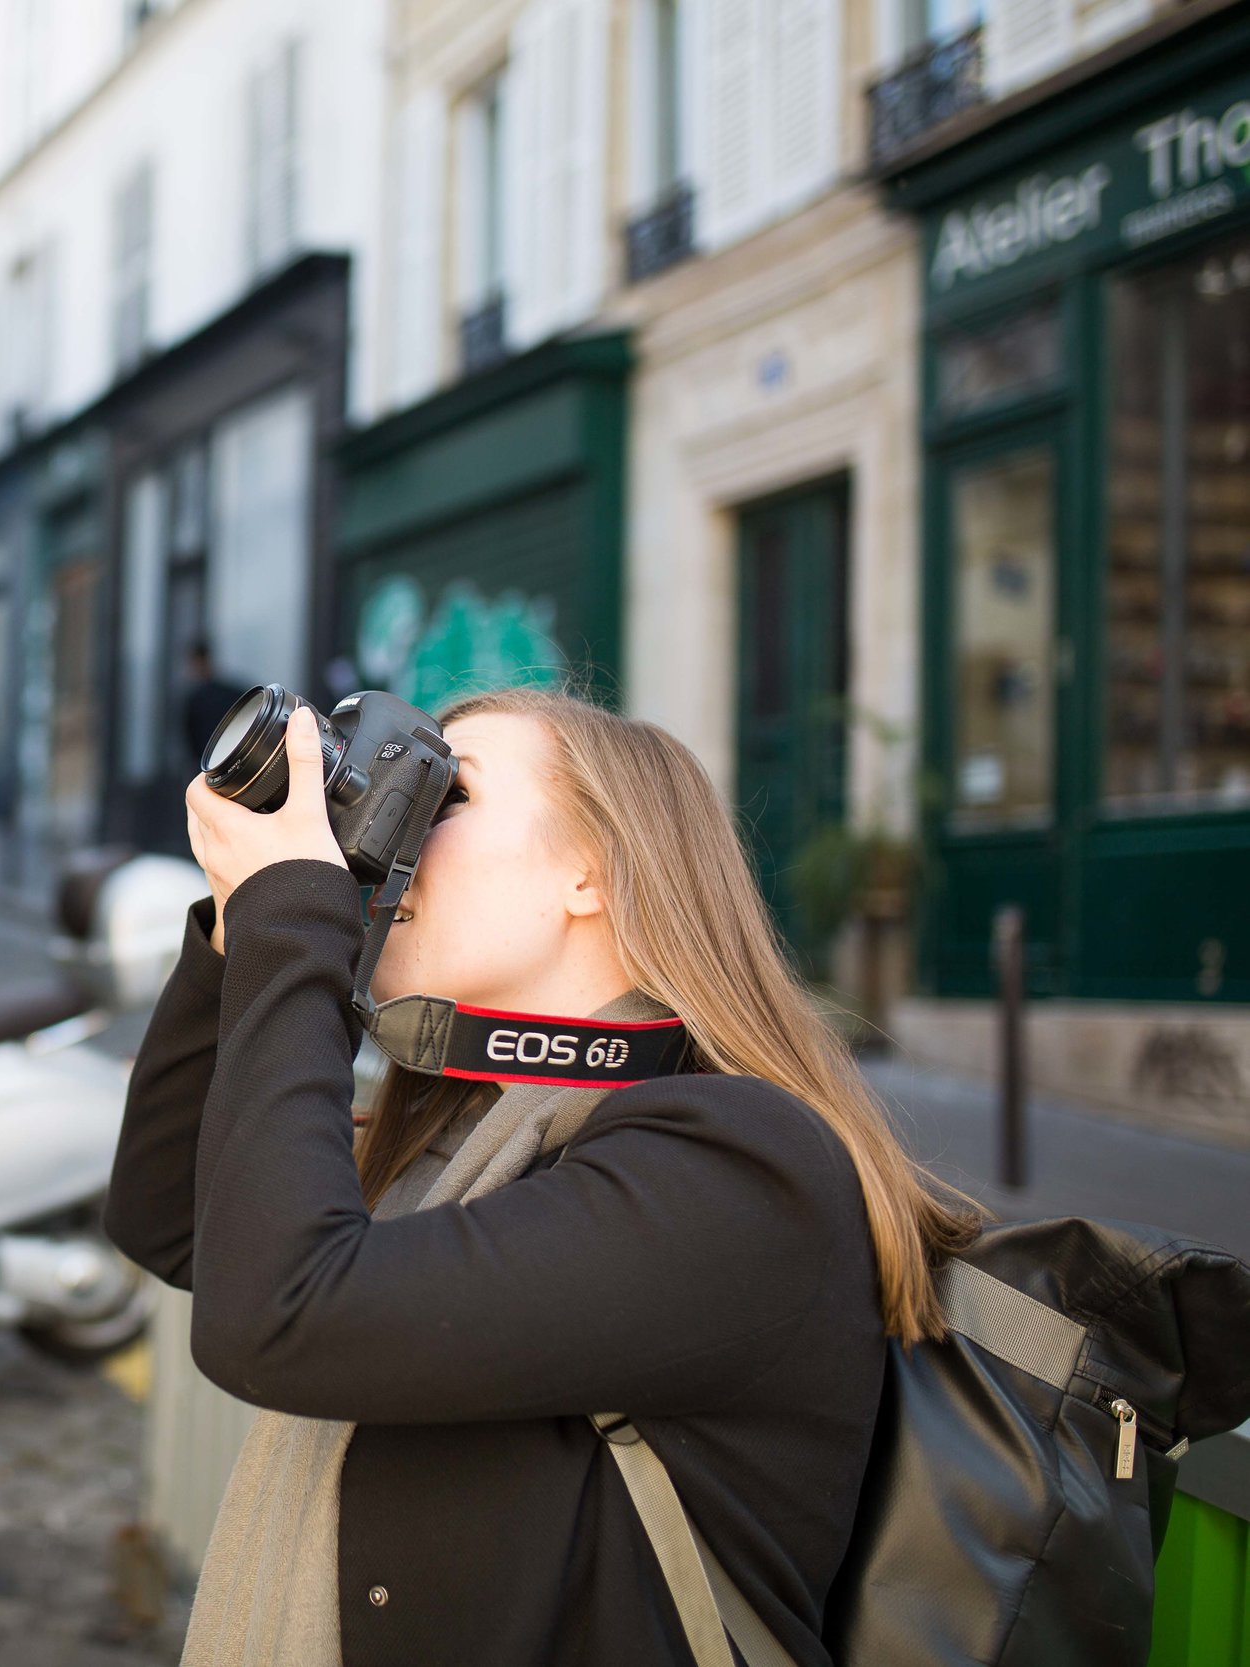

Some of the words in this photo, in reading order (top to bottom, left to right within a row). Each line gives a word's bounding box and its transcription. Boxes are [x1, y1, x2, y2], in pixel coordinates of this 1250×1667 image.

[932, 165, 1110, 288] Atelier
[381, 751, 395, 759] 6D
[384, 743, 404, 753] EOS
[487, 1029, 579, 1066] EOS
[585, 1037, 630, 1069] 6D
